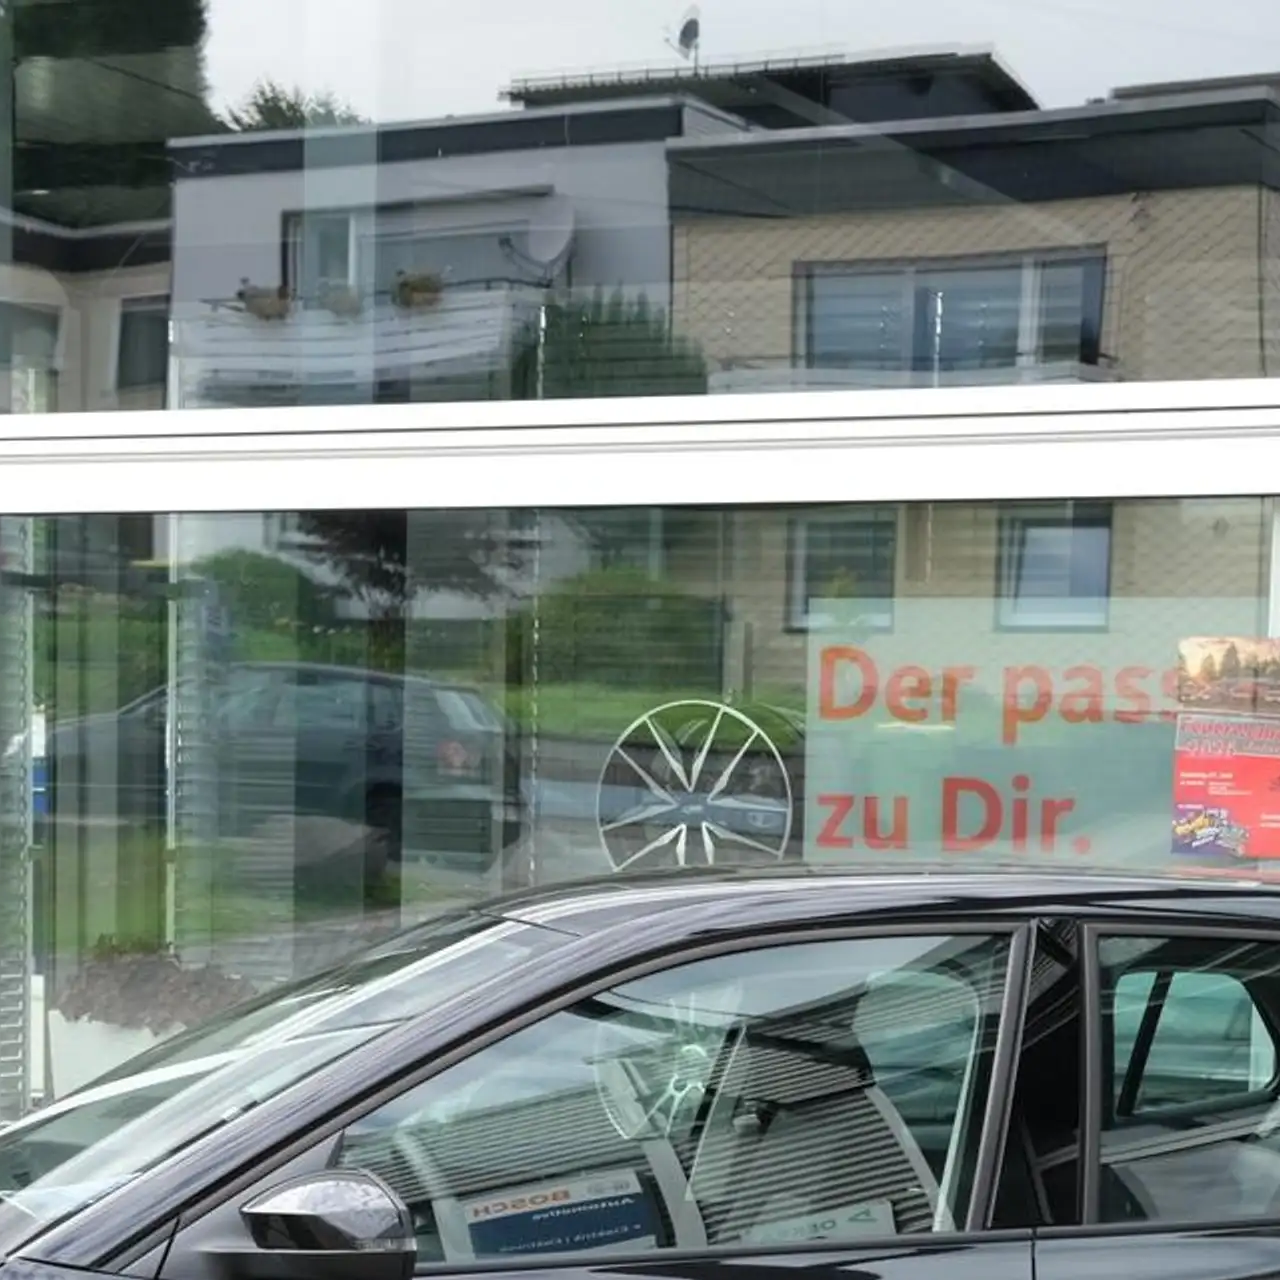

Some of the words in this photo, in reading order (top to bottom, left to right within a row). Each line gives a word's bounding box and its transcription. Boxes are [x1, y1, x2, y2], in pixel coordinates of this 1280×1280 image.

[819, 645, 974, 723] Der
[815, 794, 908, 850] zu
[941, 775, 1092, 855] Dir.
